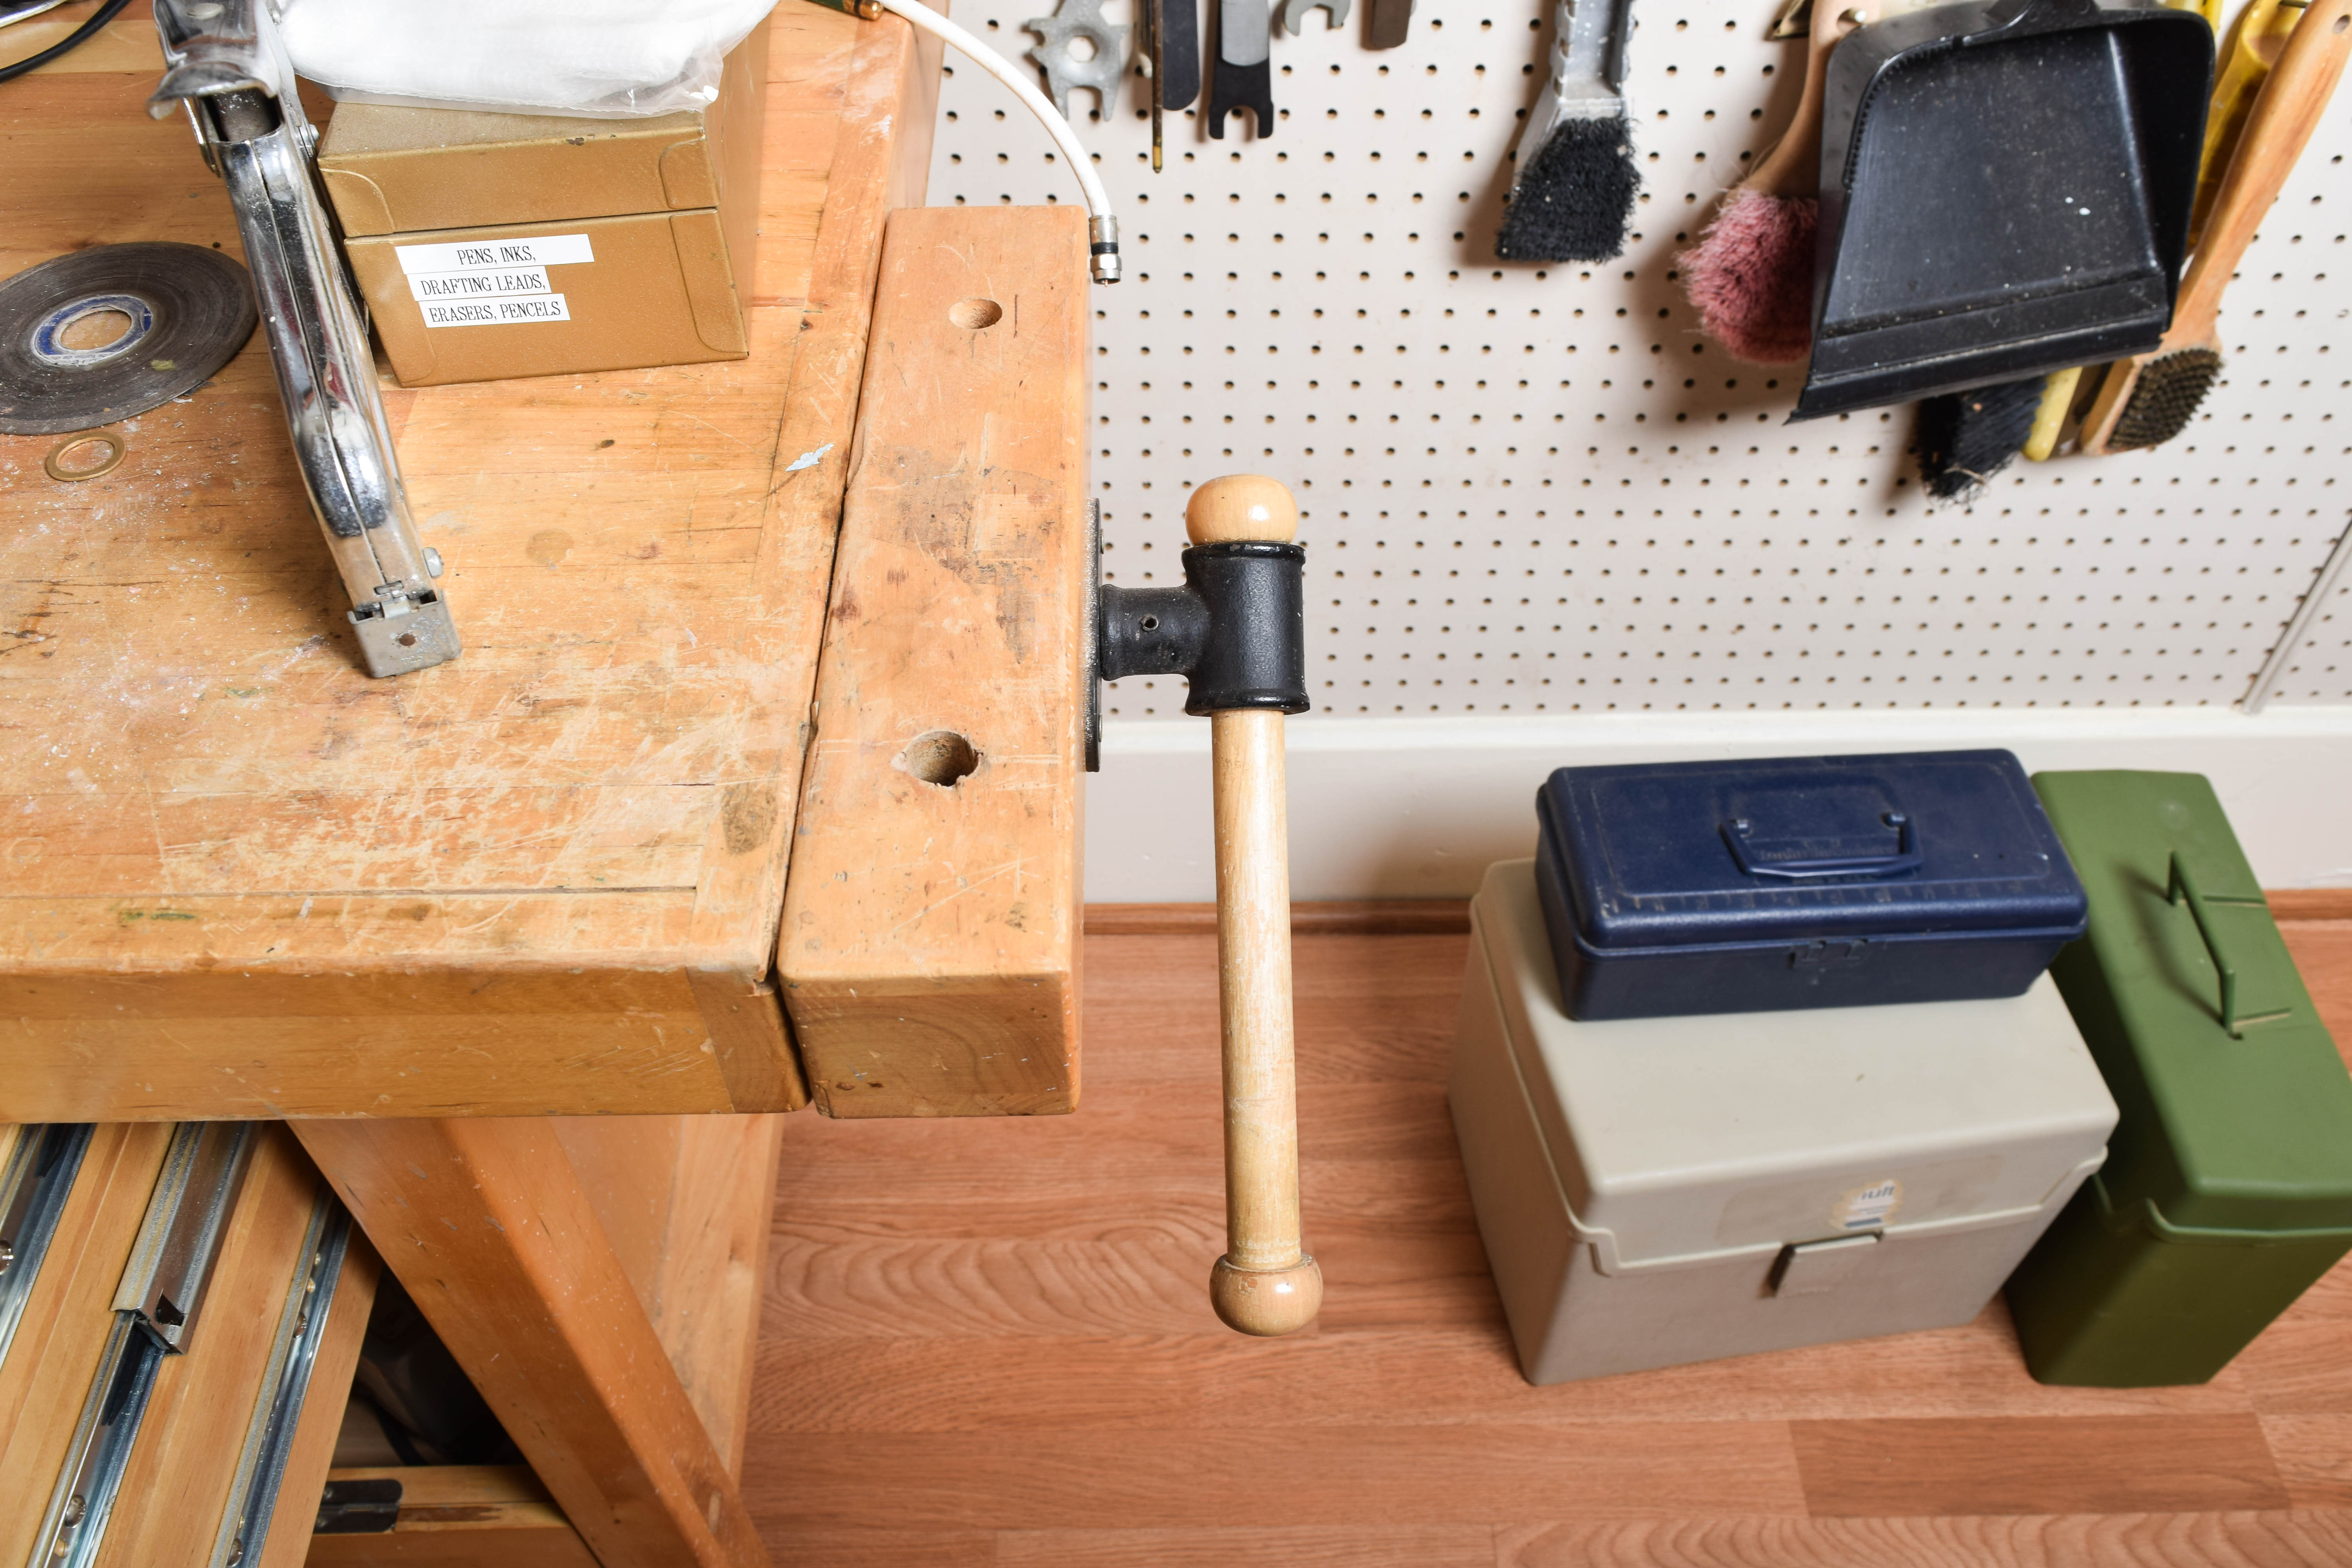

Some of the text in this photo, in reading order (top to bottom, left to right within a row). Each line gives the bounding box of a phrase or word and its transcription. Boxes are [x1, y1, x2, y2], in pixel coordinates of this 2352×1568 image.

[457, 246, 536, 265] PENS, INKS,
[421, 274, 546, 295] DRAFTING LEADS,
[428, 301, 561, 322] ERASERS, PENCELS
